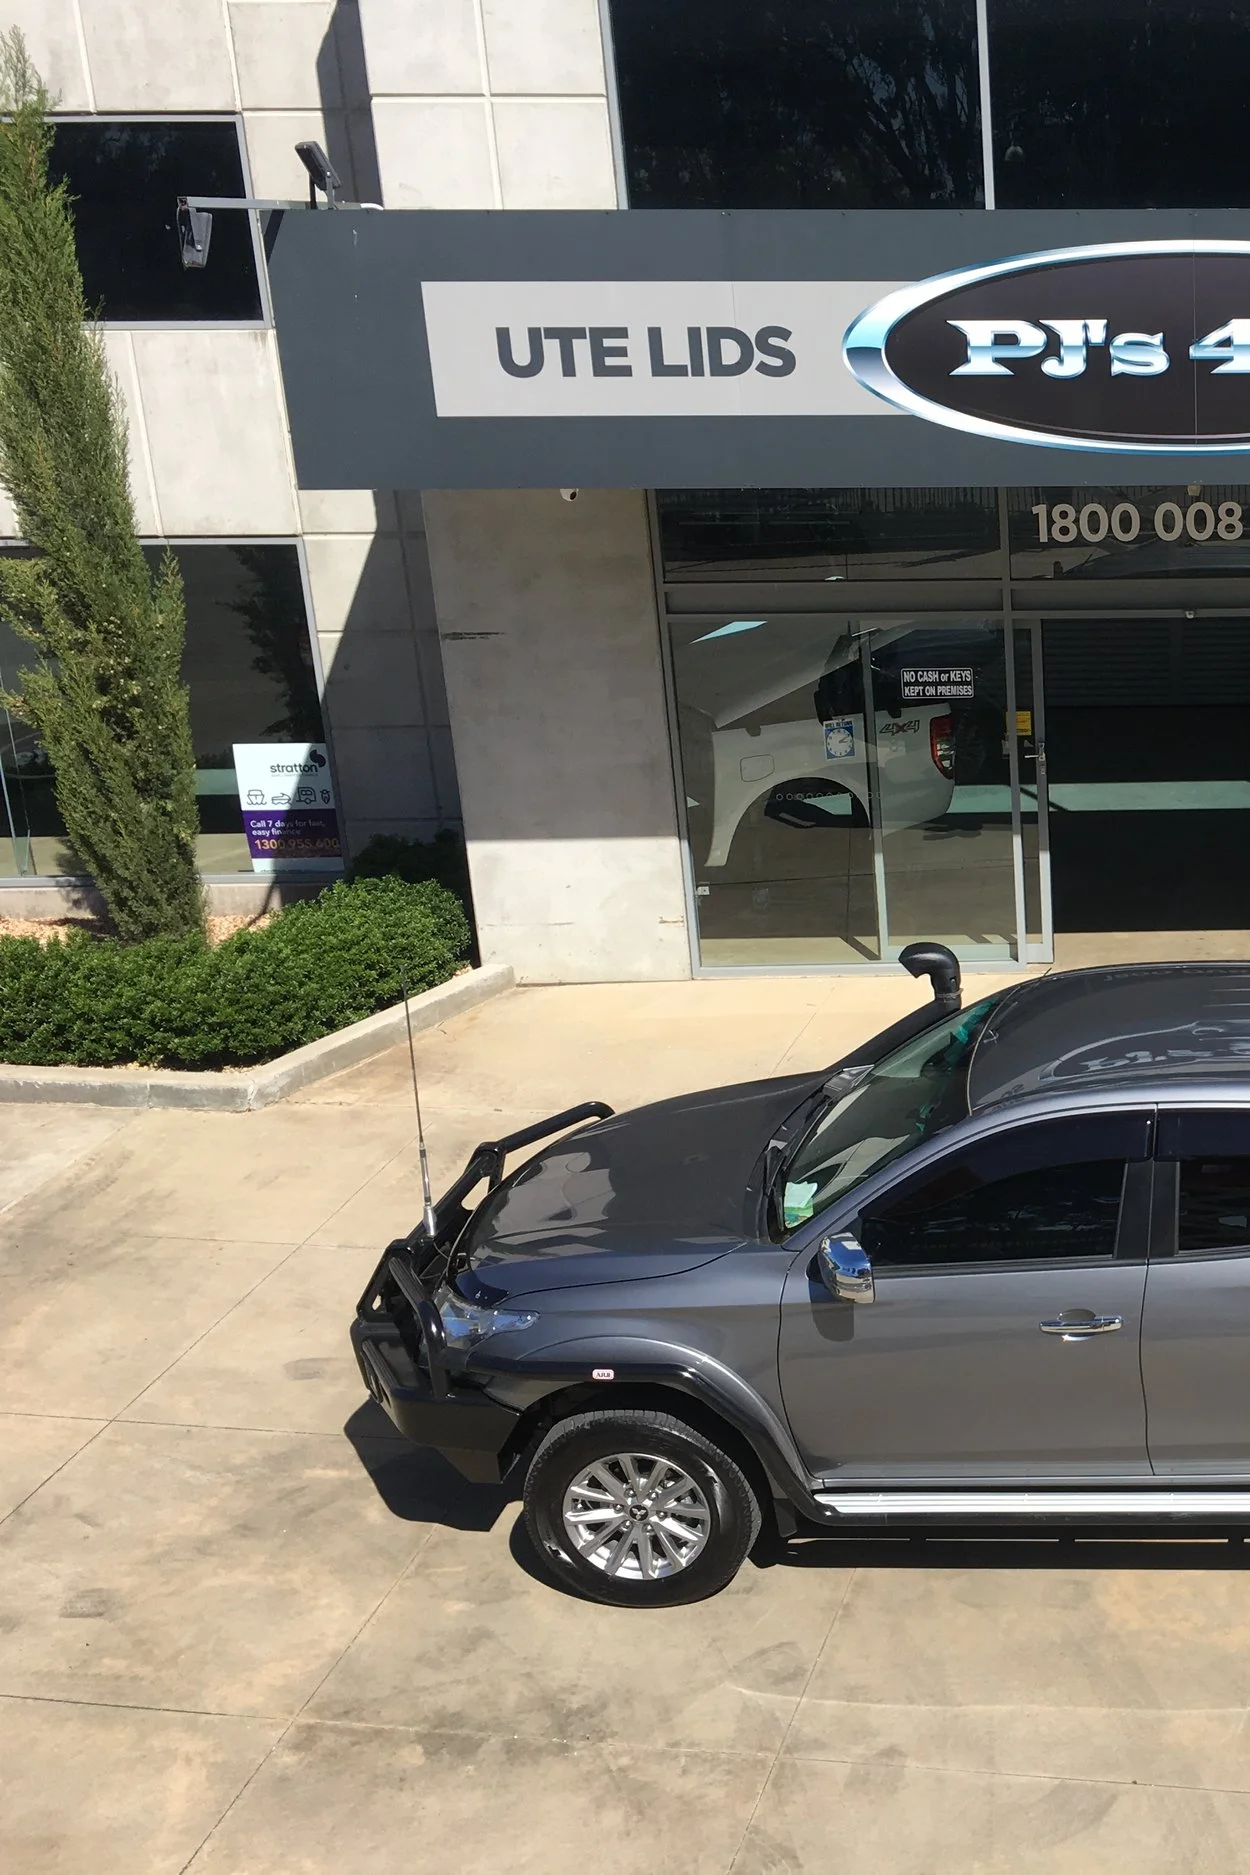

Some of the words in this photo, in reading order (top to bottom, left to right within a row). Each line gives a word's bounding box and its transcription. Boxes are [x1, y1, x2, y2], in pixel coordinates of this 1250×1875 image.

[495, 326, 633, 378] UTE
[647, 325, 797, 378] LIDS
[945, 318, 1171, 378] PJ's
[1032, 502, 1141, 543] 1800
[1154, 501, 1243, 542] 008
[903, 671, 916, 682] NO
[917, 670, 939, 682] CASH
[940, 673, 949, 682] or
[950, 670, 971, 682] KEYS
[904, 686, 924, 696] KEPT
[924, 685, 936, 696] ON
[937, 685, 972, 696] PREMISES
[270, 763, 318, 773] stratton
[250, 820, 266, 828] Call
[268, 820, 273, 828] 7
[252, 829, 270, 837] easy
[254, 839, 285, 850] 1300
